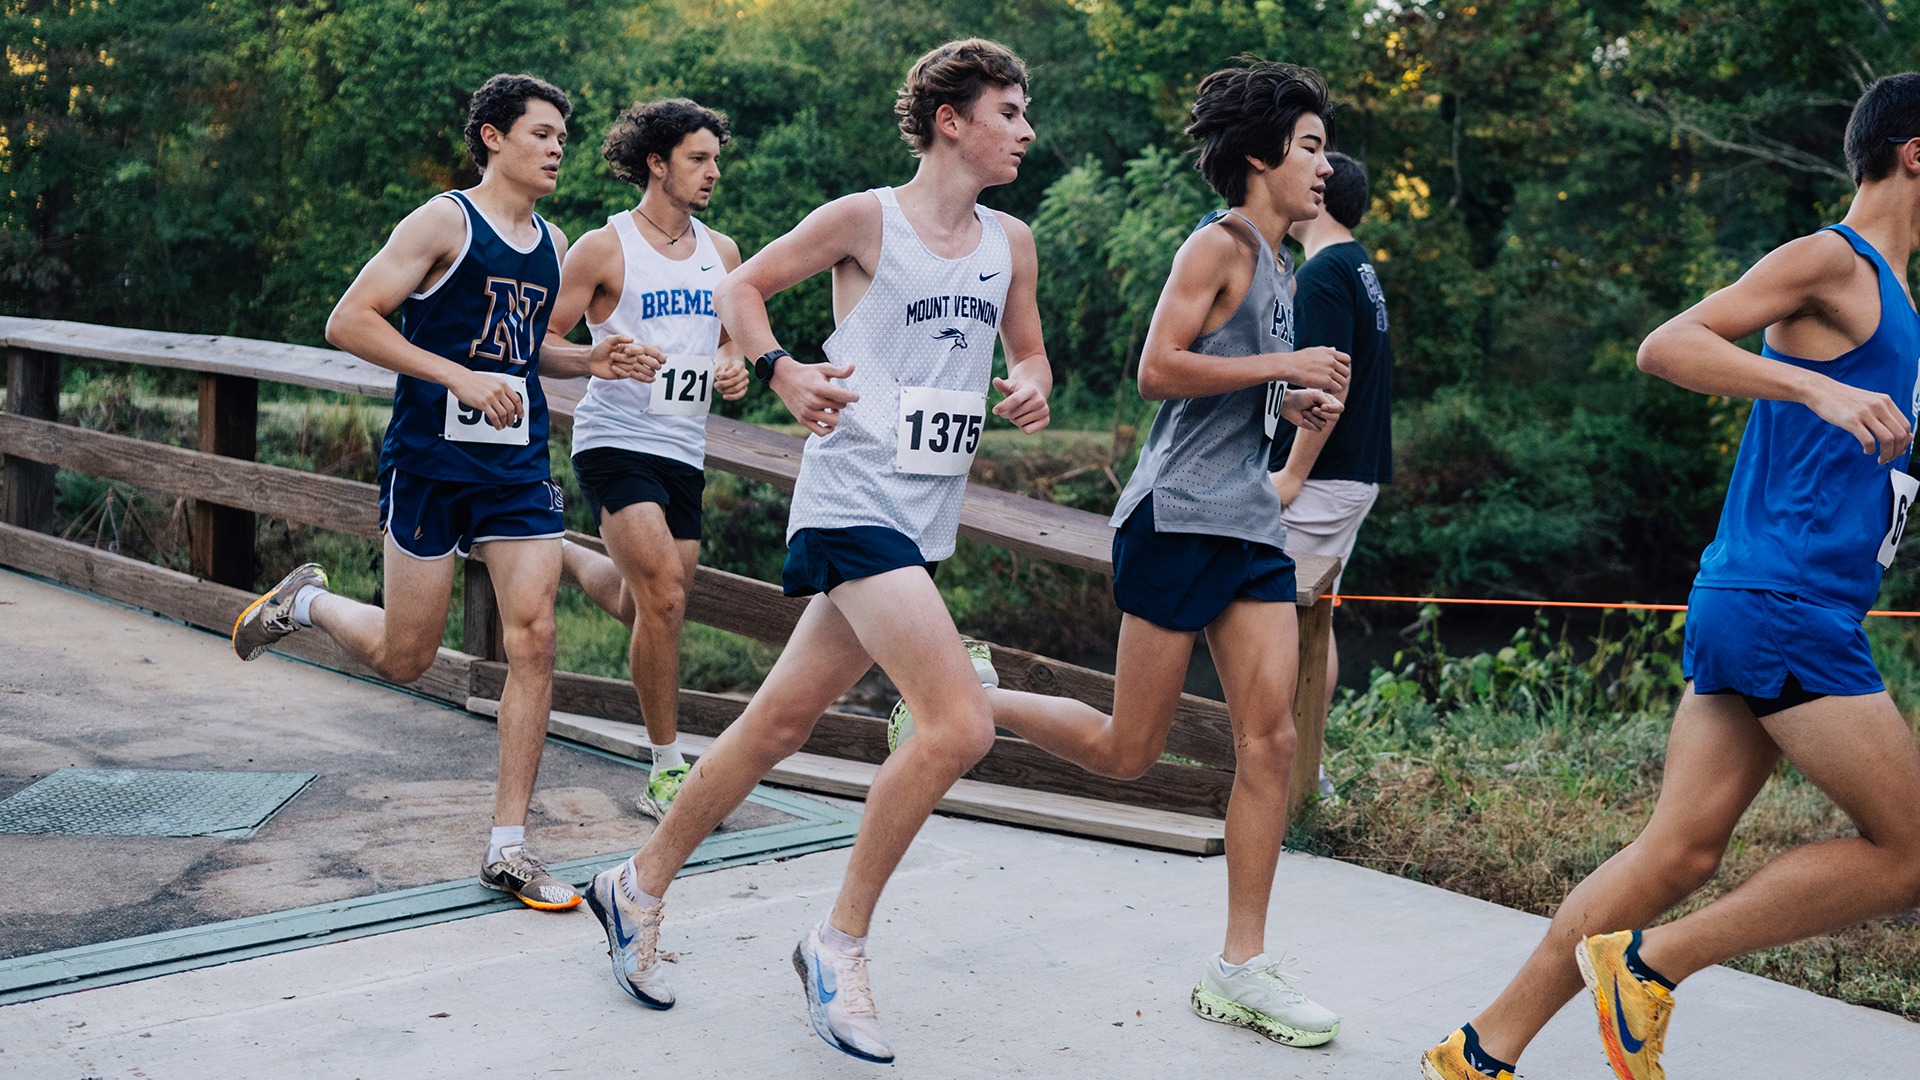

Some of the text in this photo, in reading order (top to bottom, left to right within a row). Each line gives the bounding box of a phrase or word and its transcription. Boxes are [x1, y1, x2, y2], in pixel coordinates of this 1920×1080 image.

[469, 276, 549, 365] N
[641, 288, 718, 319] BREME
[906, 295, 998, 329] MOUNT VERNON
[661, 368, 708, 402] 121
[905, 410, 982, 454] 1375
